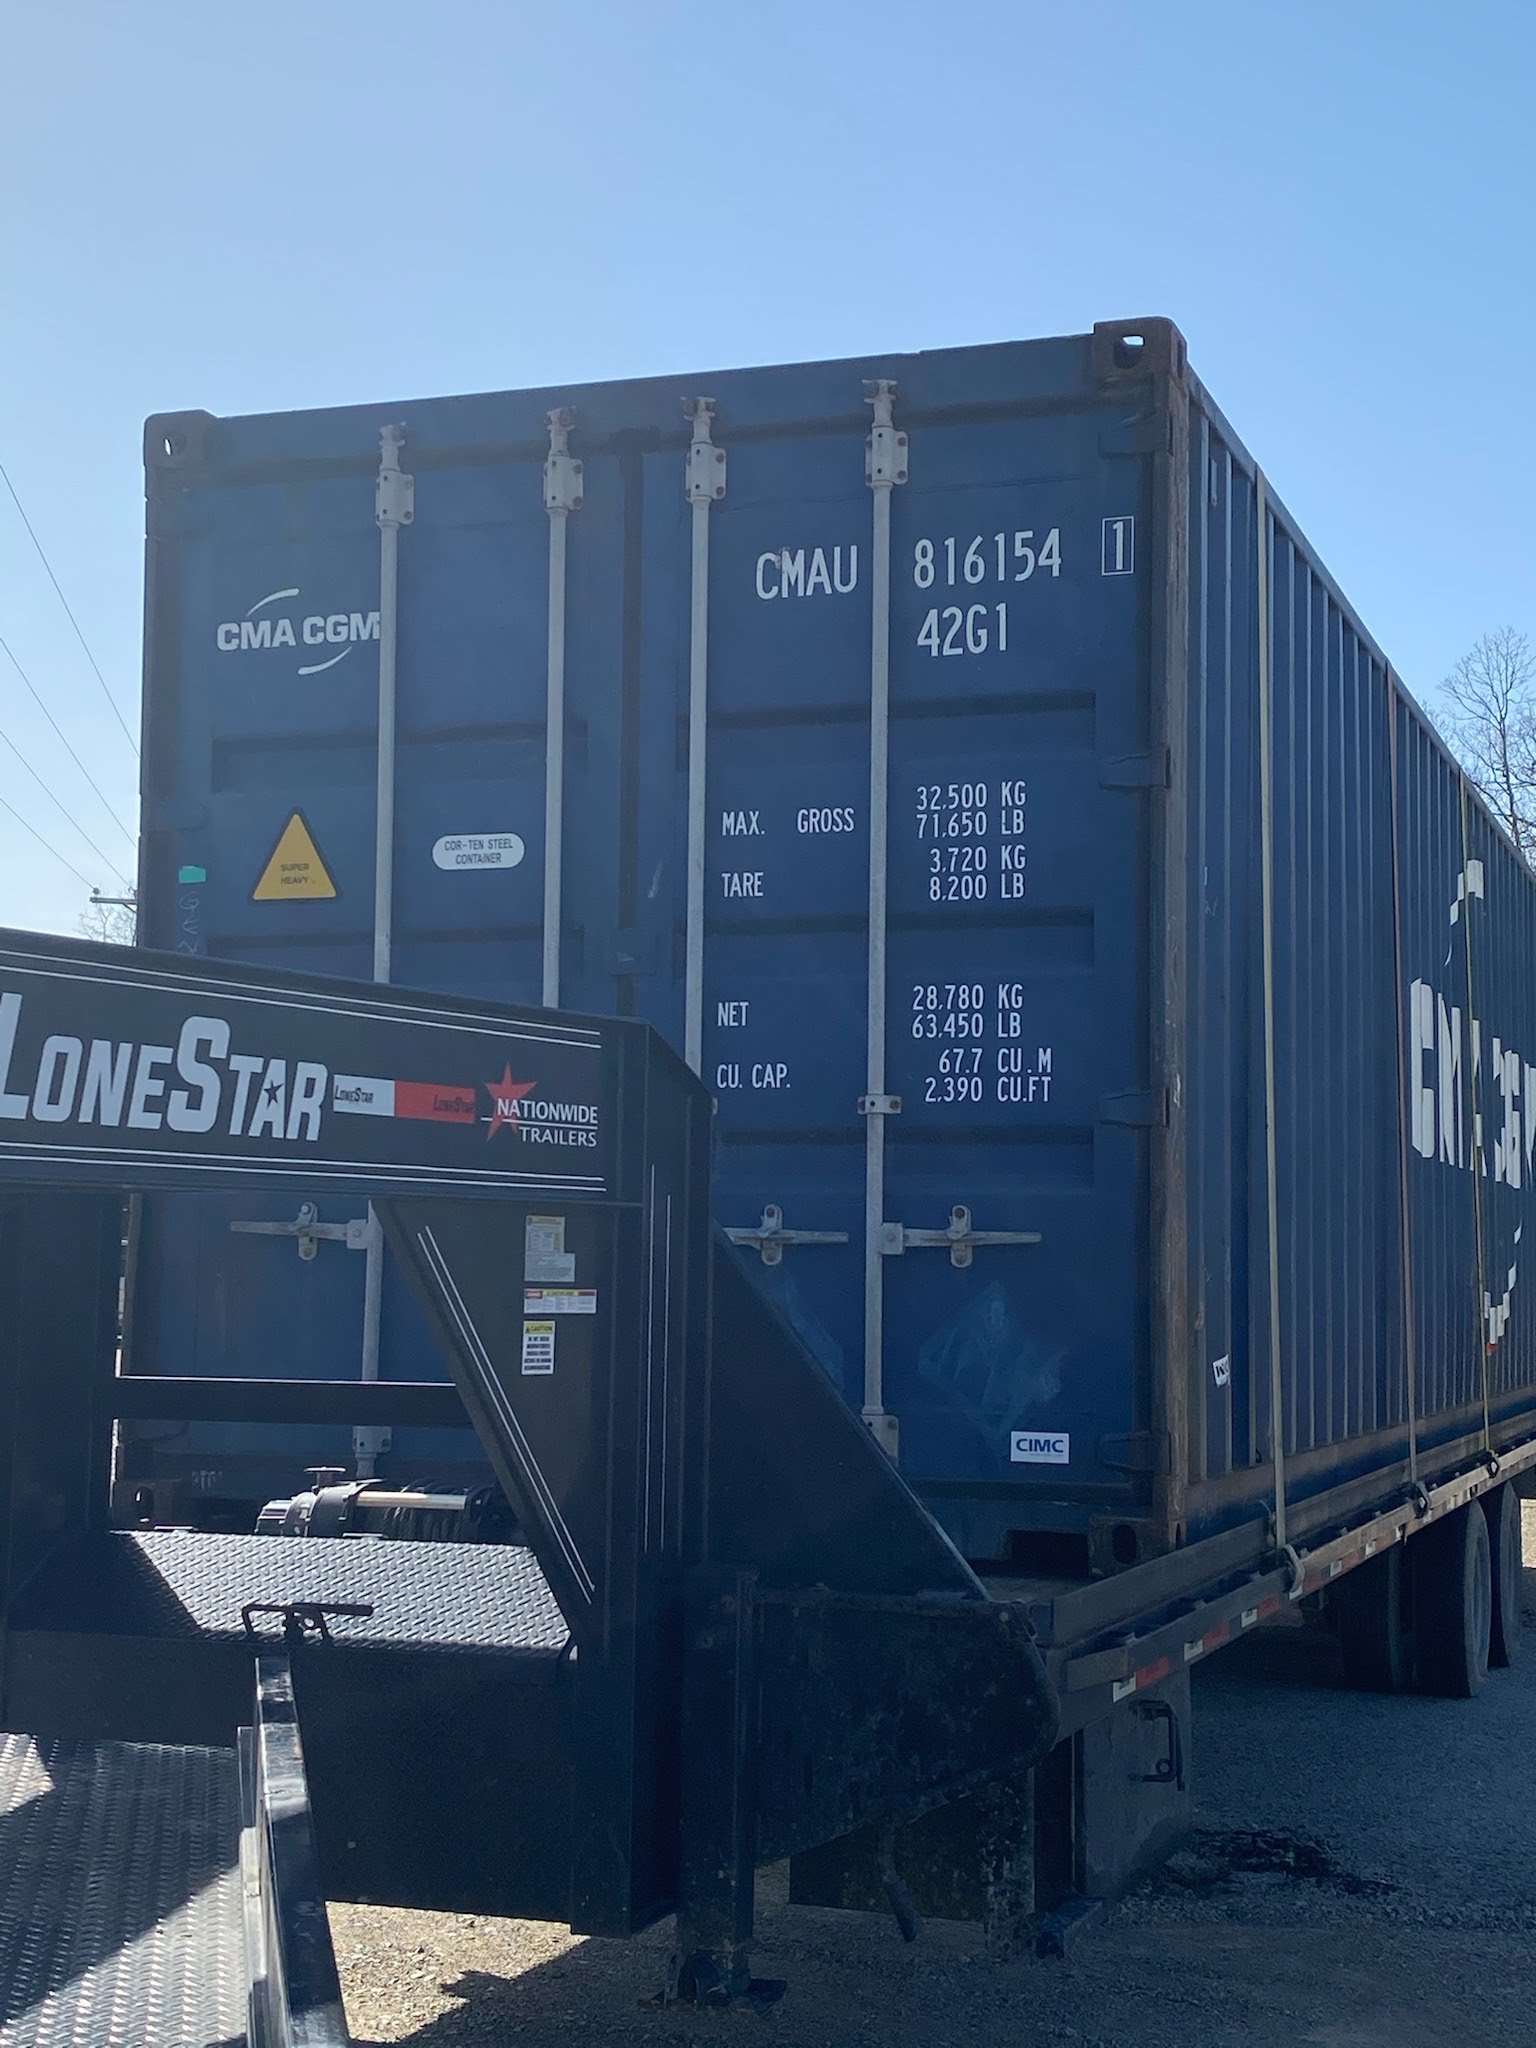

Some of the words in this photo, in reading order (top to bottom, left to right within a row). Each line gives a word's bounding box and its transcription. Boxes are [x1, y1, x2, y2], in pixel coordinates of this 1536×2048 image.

[756, 545, 858, 600] CMAU
[913, 528, 1062, 588] 816154
[1112, 520, 1125, 570] 1
[217, 618, 297, 651] CMA
[302, 611, 380, 645] CGM
[917, 602, 1007, 657] 42G1
[722, 811, 765, 836] MAX.
[797, 808, 855, 833] GROSS
[1001, 781, 1027, 806] KG
[1001, 810, 1025, 835] LB
[444, 840, 484, 851] COR-TEN
[487, 838, 513, 849] STEEL
[455, 853, 502, 865] CONTAINER
[722, 872, 764, 898] TARE
[1001, 844, 1027, 869] KG
[1001, 874, 1025, 899] LB
[717, 1001, 749, 1027] NET
[998, 984, 1023, 1009] KG
[998, 1012, 1022, 1038] LB
[716, 1065, 743, 1089] CU.
[751, 1063, 791, 1088] CAP.
[938, 1048, 984, 1074] 67.7
[498, 1098, 598, 1124] NATIONWIDE
[519, 1126, 597, 1148] TRAILERS
[1016, 1438, 1064, 1453] CIMC
